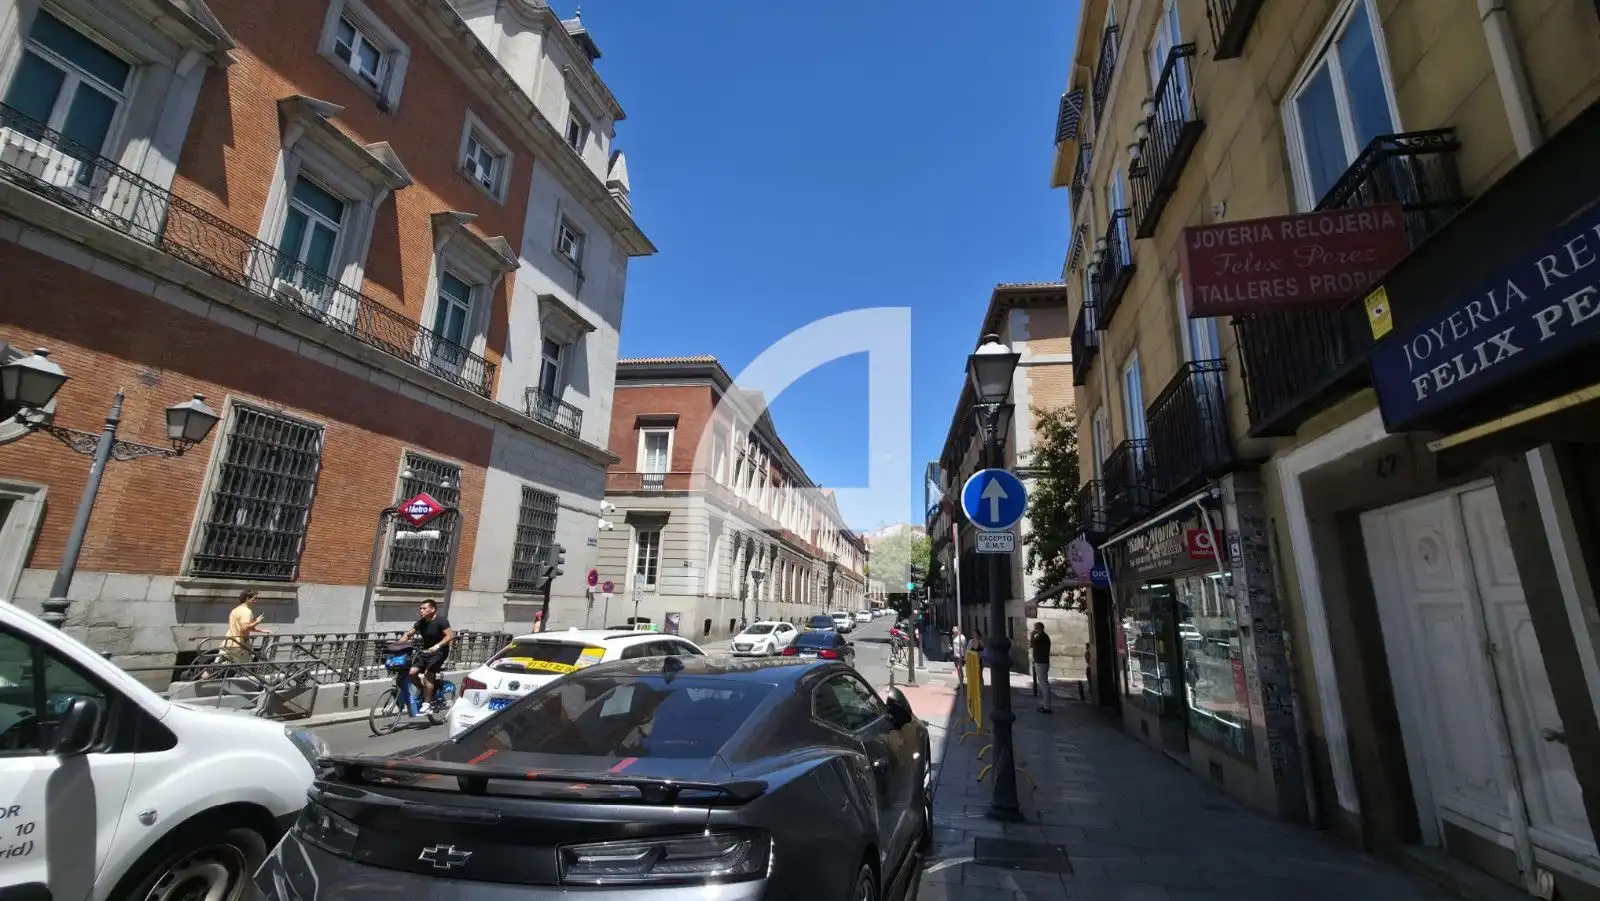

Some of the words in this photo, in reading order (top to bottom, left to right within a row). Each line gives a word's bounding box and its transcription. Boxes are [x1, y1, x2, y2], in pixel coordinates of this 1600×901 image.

[1193, 225, 1275, 250] JOYERIA
[1281, 210, 1396, 240] RELOJERIA
[1212, 251, 1283, 277] Felix
[1293, 244, 1378, 268] Perez
[1198, 276, 1299, 305] TALLERES
[1402, 277, 1532, 375] JOYERIA
[1411, 325, 1525, 402] FELIX
[1531, 281, 1600, 342] PE
[408, 505, 429, 513] Metro
[15, 821, 35, 837] 10
